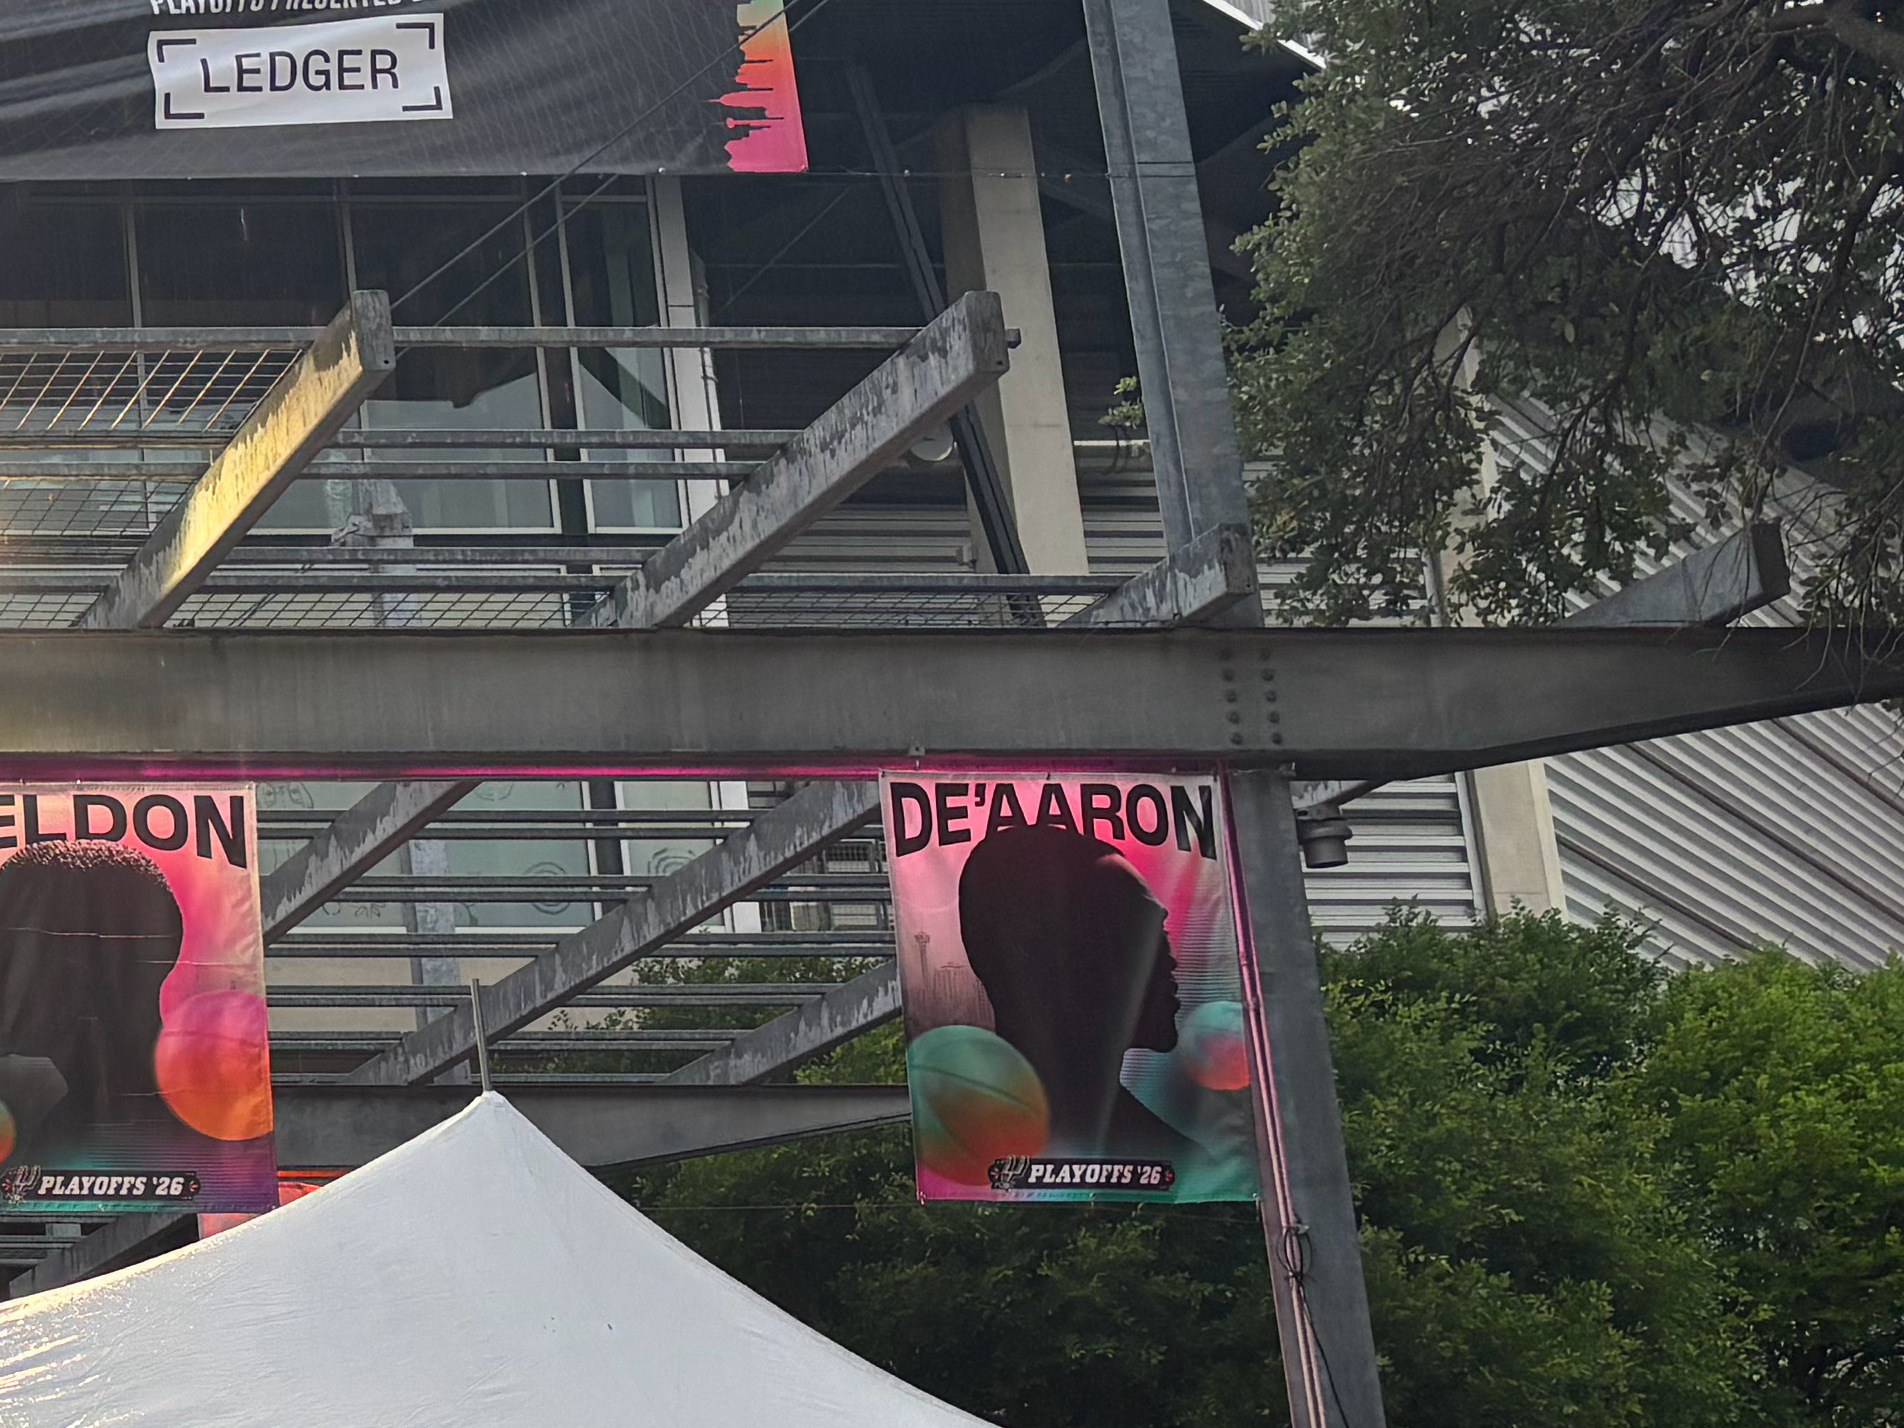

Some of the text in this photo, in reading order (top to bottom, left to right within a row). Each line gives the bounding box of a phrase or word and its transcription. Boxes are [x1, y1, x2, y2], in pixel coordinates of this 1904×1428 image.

[200, 49, 399, 92] LEDGER
[890, 781, 1217, 861] DE'AARON
[38, 1175, 185, 1197] PLAYOFFS '26
[1028, 1164, 1163, 1185] PLAYOFFS '26
